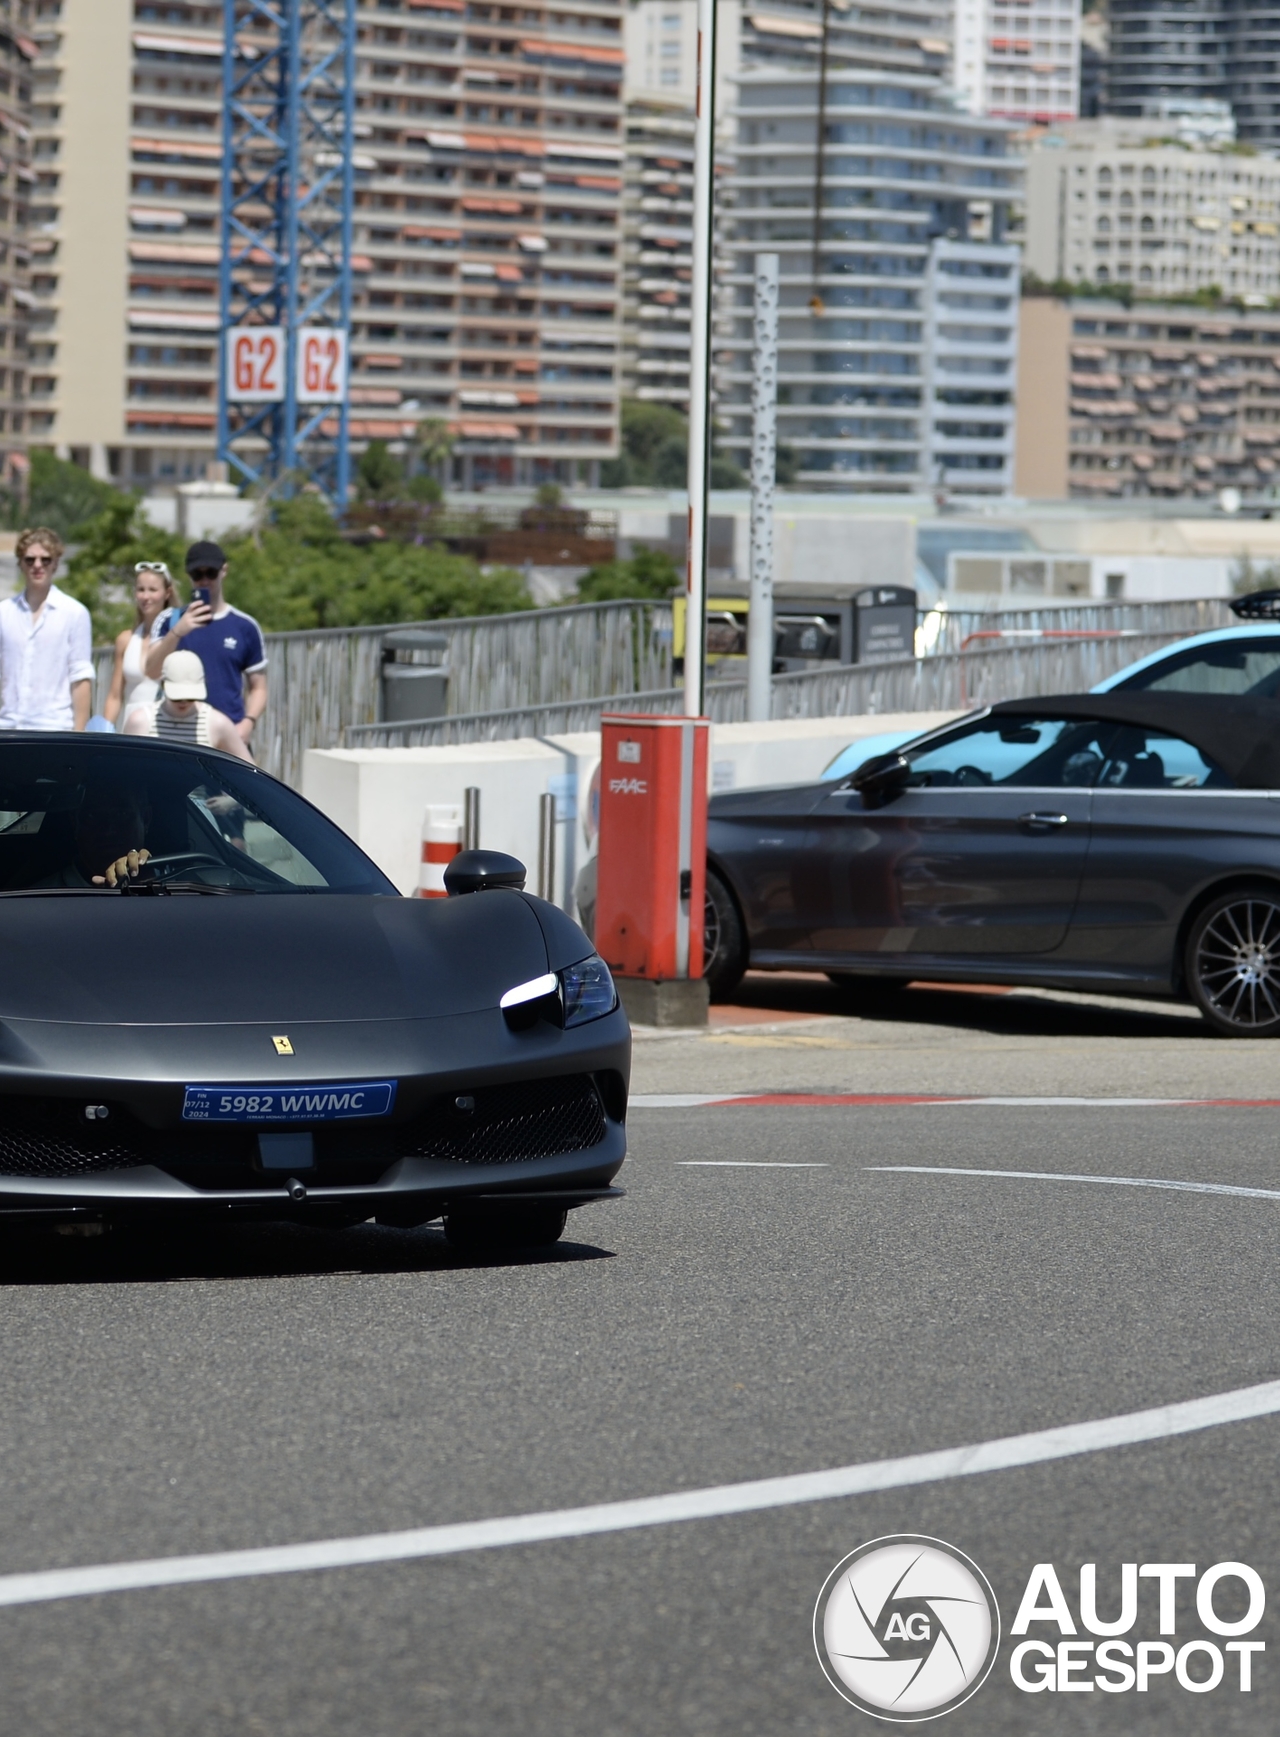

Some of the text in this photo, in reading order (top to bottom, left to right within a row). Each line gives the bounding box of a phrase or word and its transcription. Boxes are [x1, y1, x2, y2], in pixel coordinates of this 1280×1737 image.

[235, 336, 276, 391] G2
[305, 338, 339, 391] G2
[609, 779, 647, 794] FAAC
[185, 1101, 210, 1109] 07/12
[219, 1093, 364, 1112] 5982 WWMC
